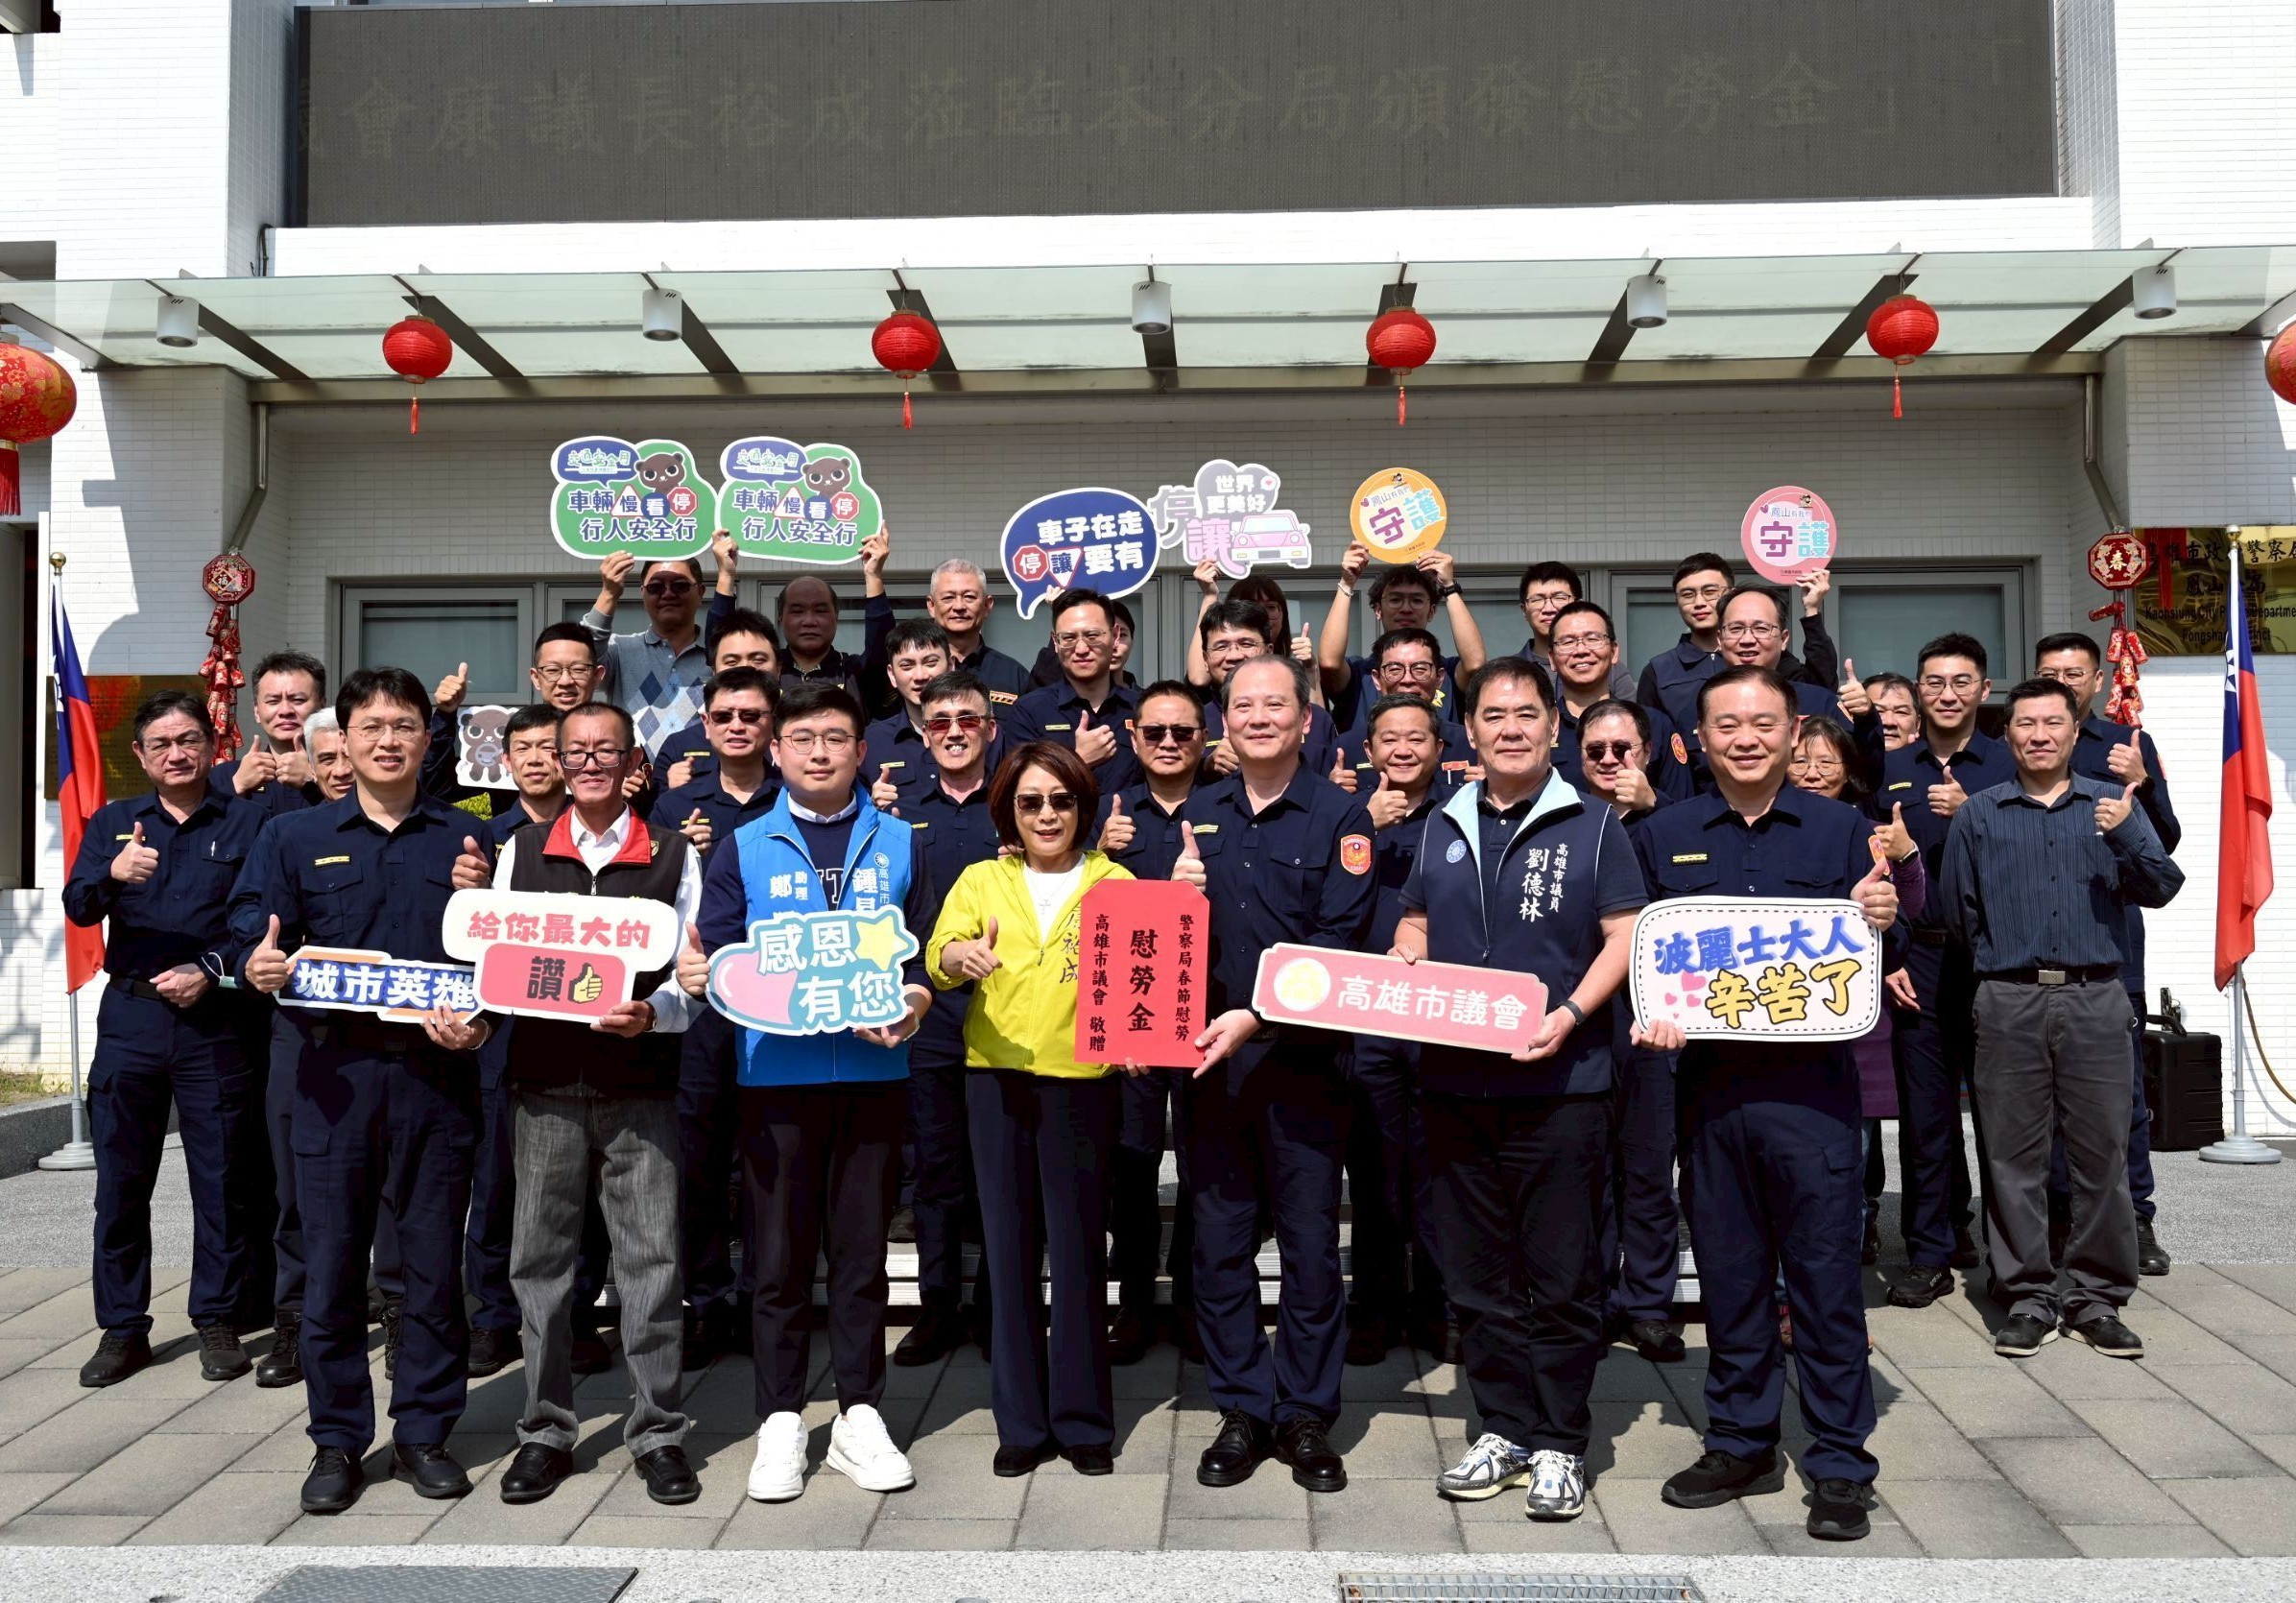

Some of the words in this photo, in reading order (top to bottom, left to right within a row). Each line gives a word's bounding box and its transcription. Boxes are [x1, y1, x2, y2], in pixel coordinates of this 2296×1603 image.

[1207, 494, 1266, 514] 更美好
[1215, 474, 1255, 493] 世界
[581, 517, 697, 541] 行人安全行
[743, 516, 858, 545] 行人安全行
[1038, 511, 1143, 545] 車子在走
[1369, 489, 1442, 544] 守護
[1760, 520, 1829, 558] 守護
[2109, 550, 2127, 570] 春
[2145, 606, 2196, 622] Kaohsiung
[2198, 604, 2217, 622] City
[2183, 629, 2229, 645] Fongsha
[795, 871, 808, 900] 助理
[879, 868, 891, 904] 高雄市
[1519, 848, 1549, 922] 劉德林
[1549, 844, 1568, 912] 高雄市議員
[466, 911, 651, 949] 給你最大的
[758, 920, 858, 974] 感恩
[1653, 916, 1866, 975] 波麗士大人
[527, 954, 565, 1003] 讚
[1091, 914, 1111, 1006] 高雄市議會
[1128, 929, 1159, 1033] 慰勞金
[1175, 915, 1194, 1041] 警察局春節慰勞
[296, 961, 478, 1013] 城市英雄
[798, 970, 897, 1024] 有您
[1337, 974, 1528, 1031] 高雄市議會
[1705, 958, 1862, 1030] 辛苦了
[1089, 1017, 1107, 1052] 敬贈
